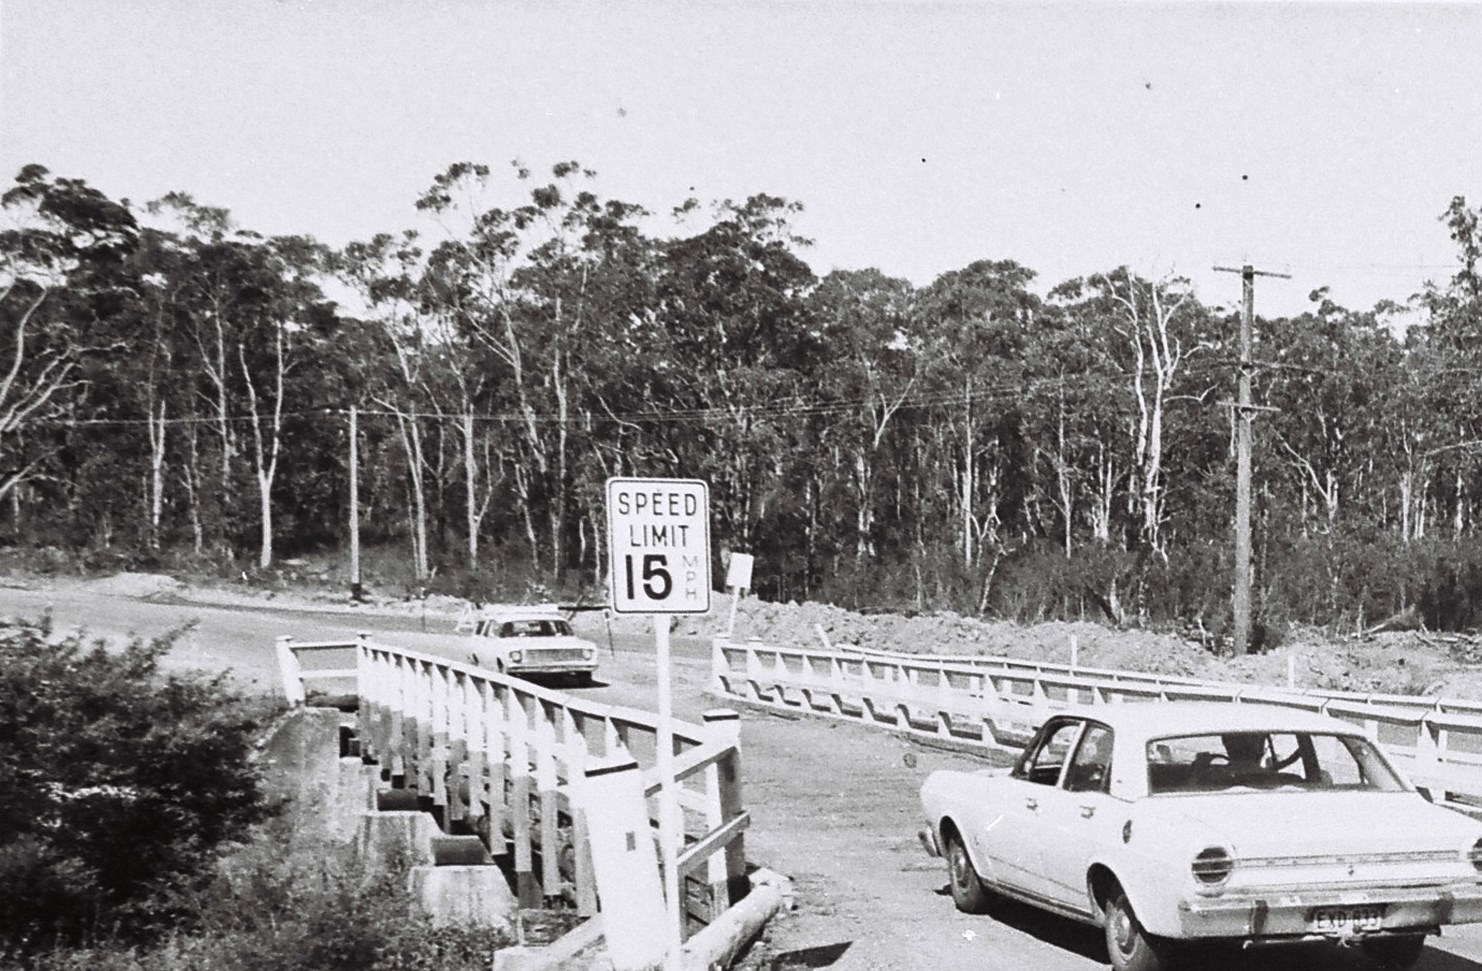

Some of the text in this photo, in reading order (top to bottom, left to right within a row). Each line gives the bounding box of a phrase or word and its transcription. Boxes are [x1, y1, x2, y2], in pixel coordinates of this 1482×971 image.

[618, 492, 697, 516] SPEED
[630, 524, 689, 548] LIMIT
[625, 554, 673, 600] 15
[683, 555, 698, 600] MPH
